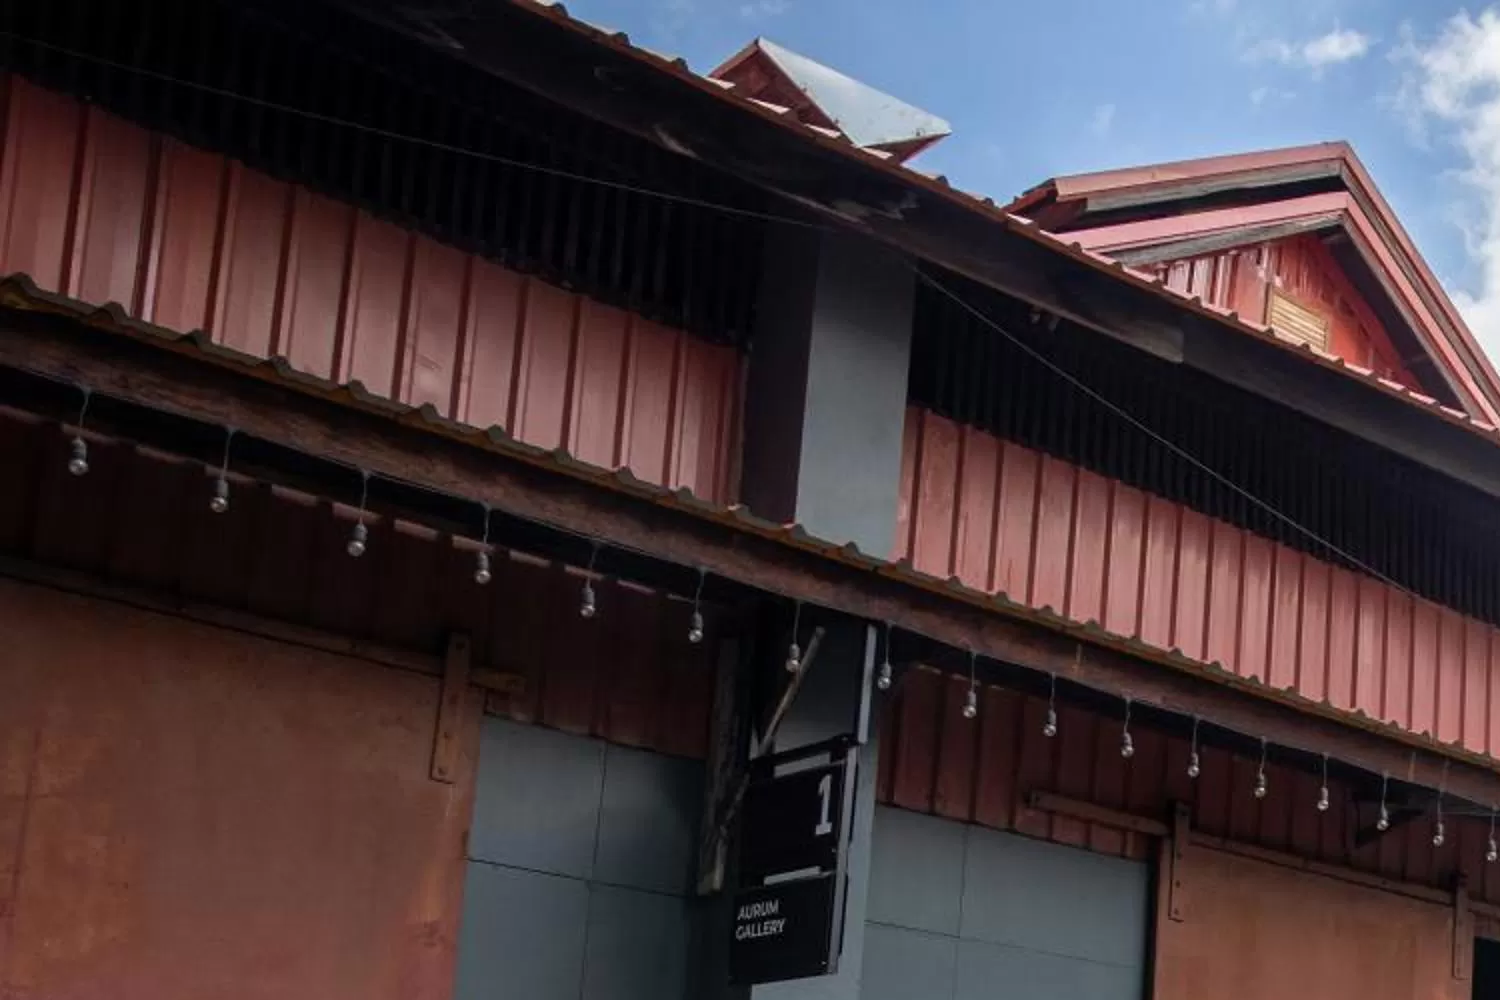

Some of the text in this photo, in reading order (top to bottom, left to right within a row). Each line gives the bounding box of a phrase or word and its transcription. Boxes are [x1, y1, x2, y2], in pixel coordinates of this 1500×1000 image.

[815, 774, 832, 835] 1
[737, 899, 779, 920] AURUM
[735, 919, 786, 940] GALLERY
